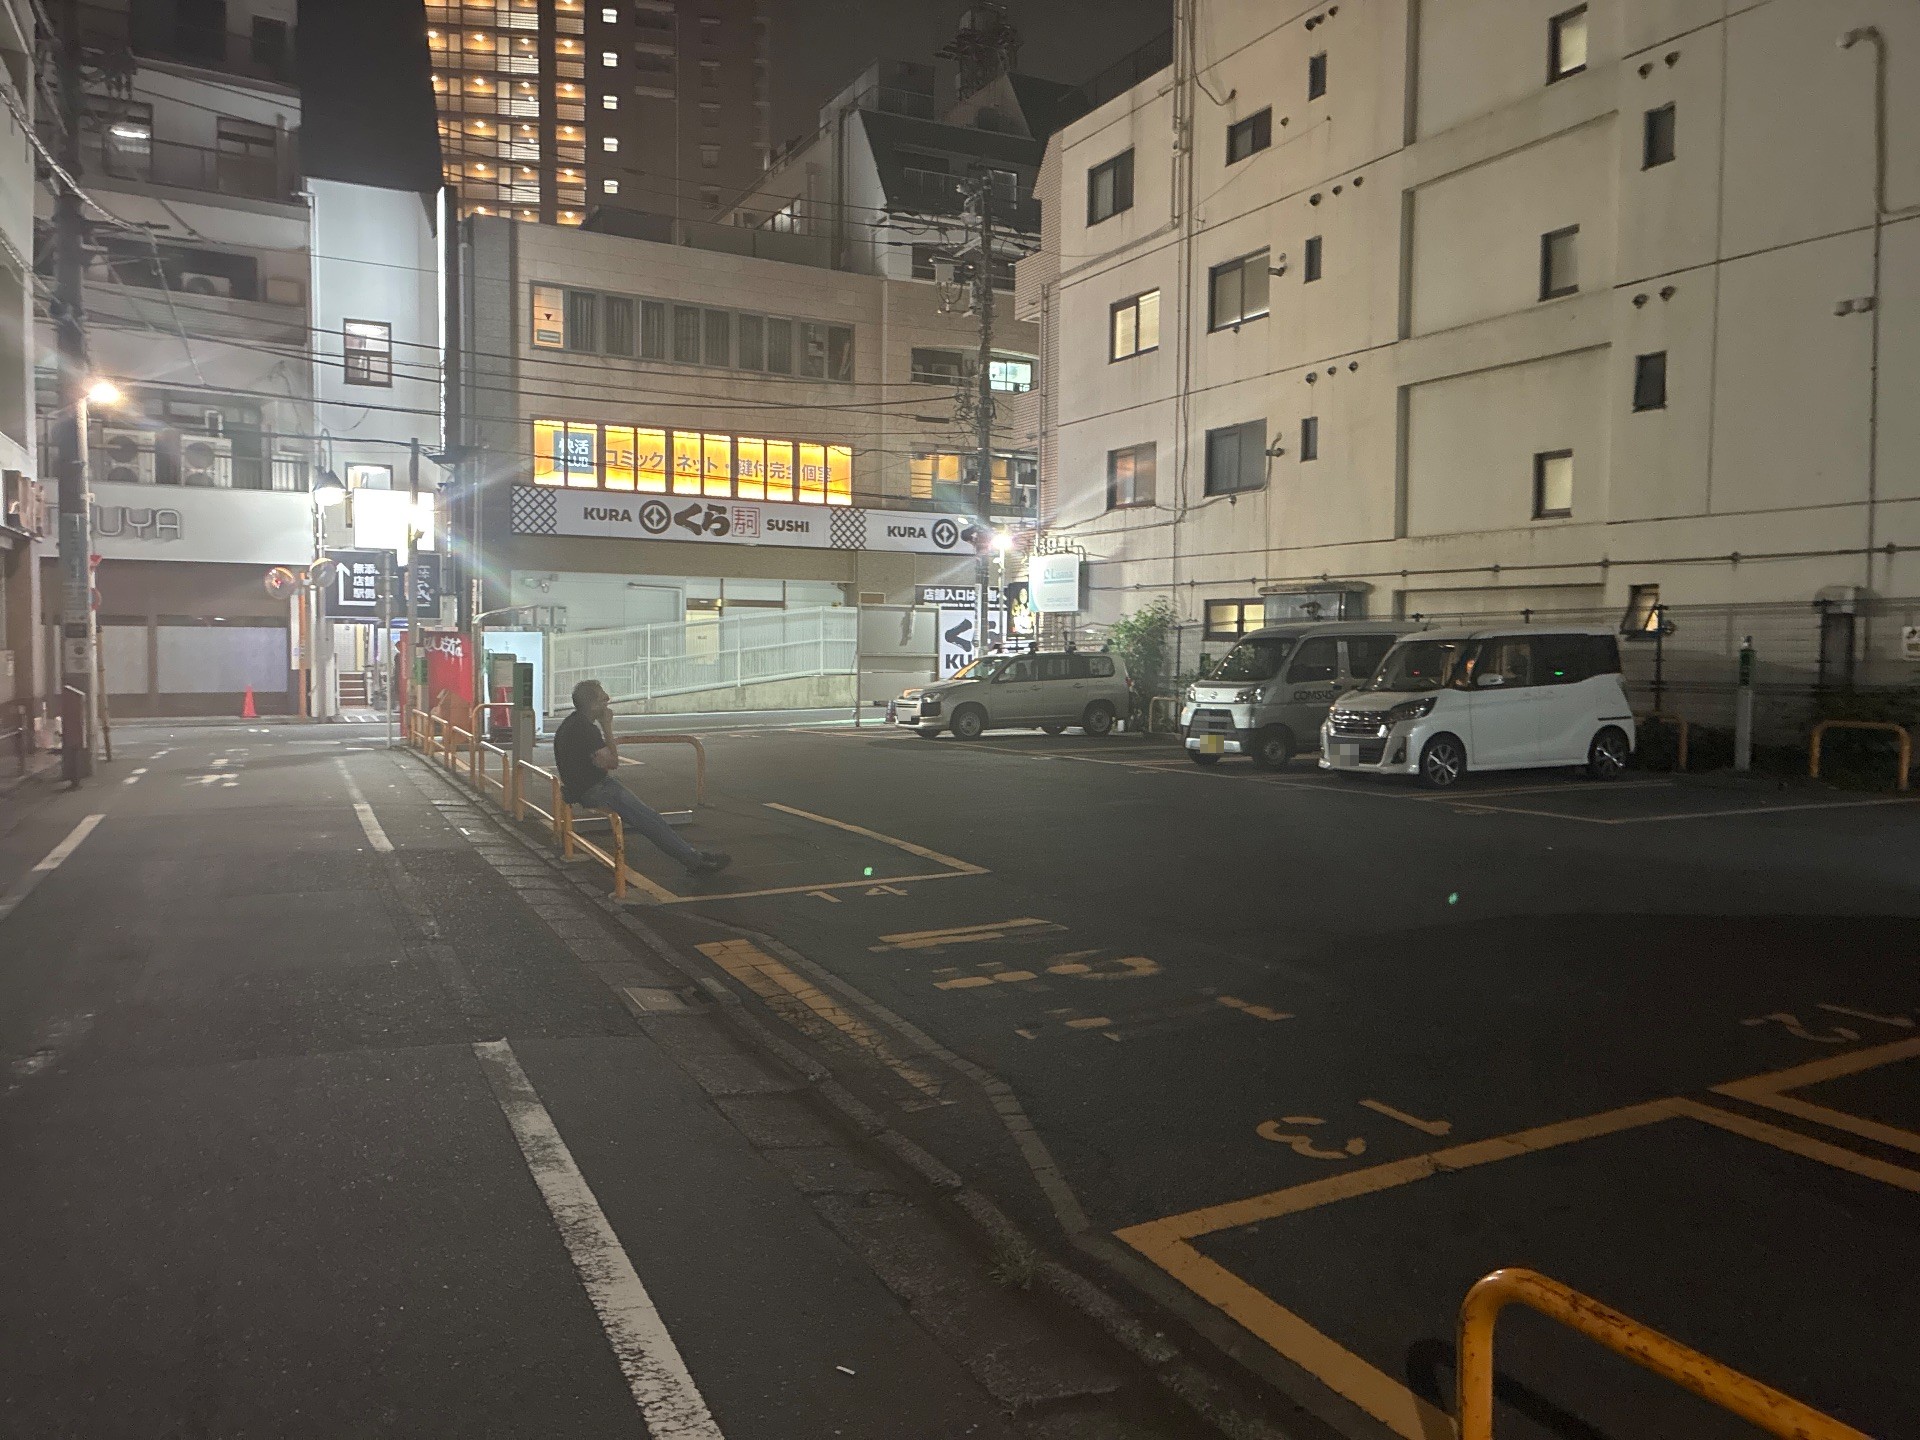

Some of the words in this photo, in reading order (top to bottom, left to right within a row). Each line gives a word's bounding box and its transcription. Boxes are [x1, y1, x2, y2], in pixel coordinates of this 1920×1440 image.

[558, 437, 589, 455] 快活
[605, 450, 664, 468] コミック
[97, 507, 181, 540] UYA
[583, 506, 633, 523] KURA
[766, 518, 810, 533] SUSHI
[887, 525, 927, 539] KURA
[805, 885, 908, 903] 14
[1256, 1097, 1453, 1160] 13
